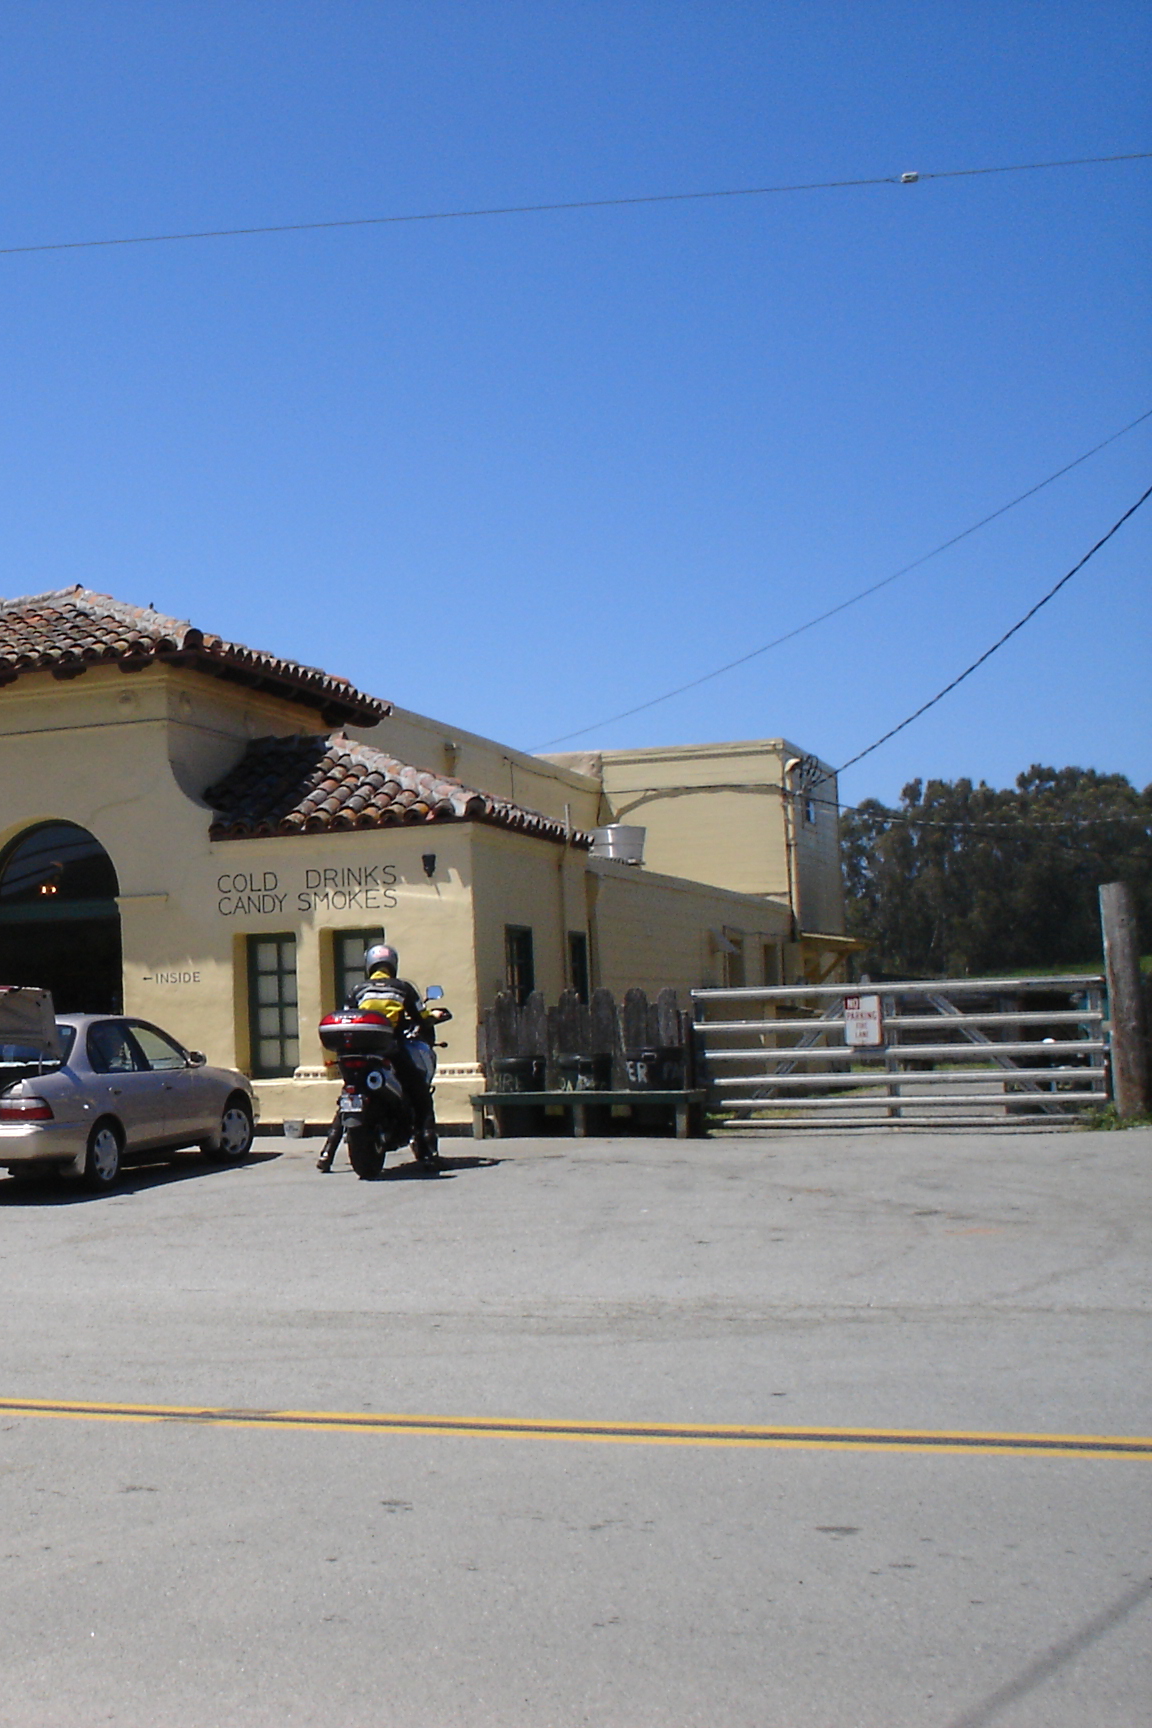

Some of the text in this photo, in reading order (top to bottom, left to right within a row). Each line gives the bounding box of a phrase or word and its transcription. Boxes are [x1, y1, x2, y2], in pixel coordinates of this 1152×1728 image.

[217, 865, 397, 894] COLD DRINKS
[218, 888, 397, 916] CANDY SMOKES
[156, 972, 201, 984] INSIDE
